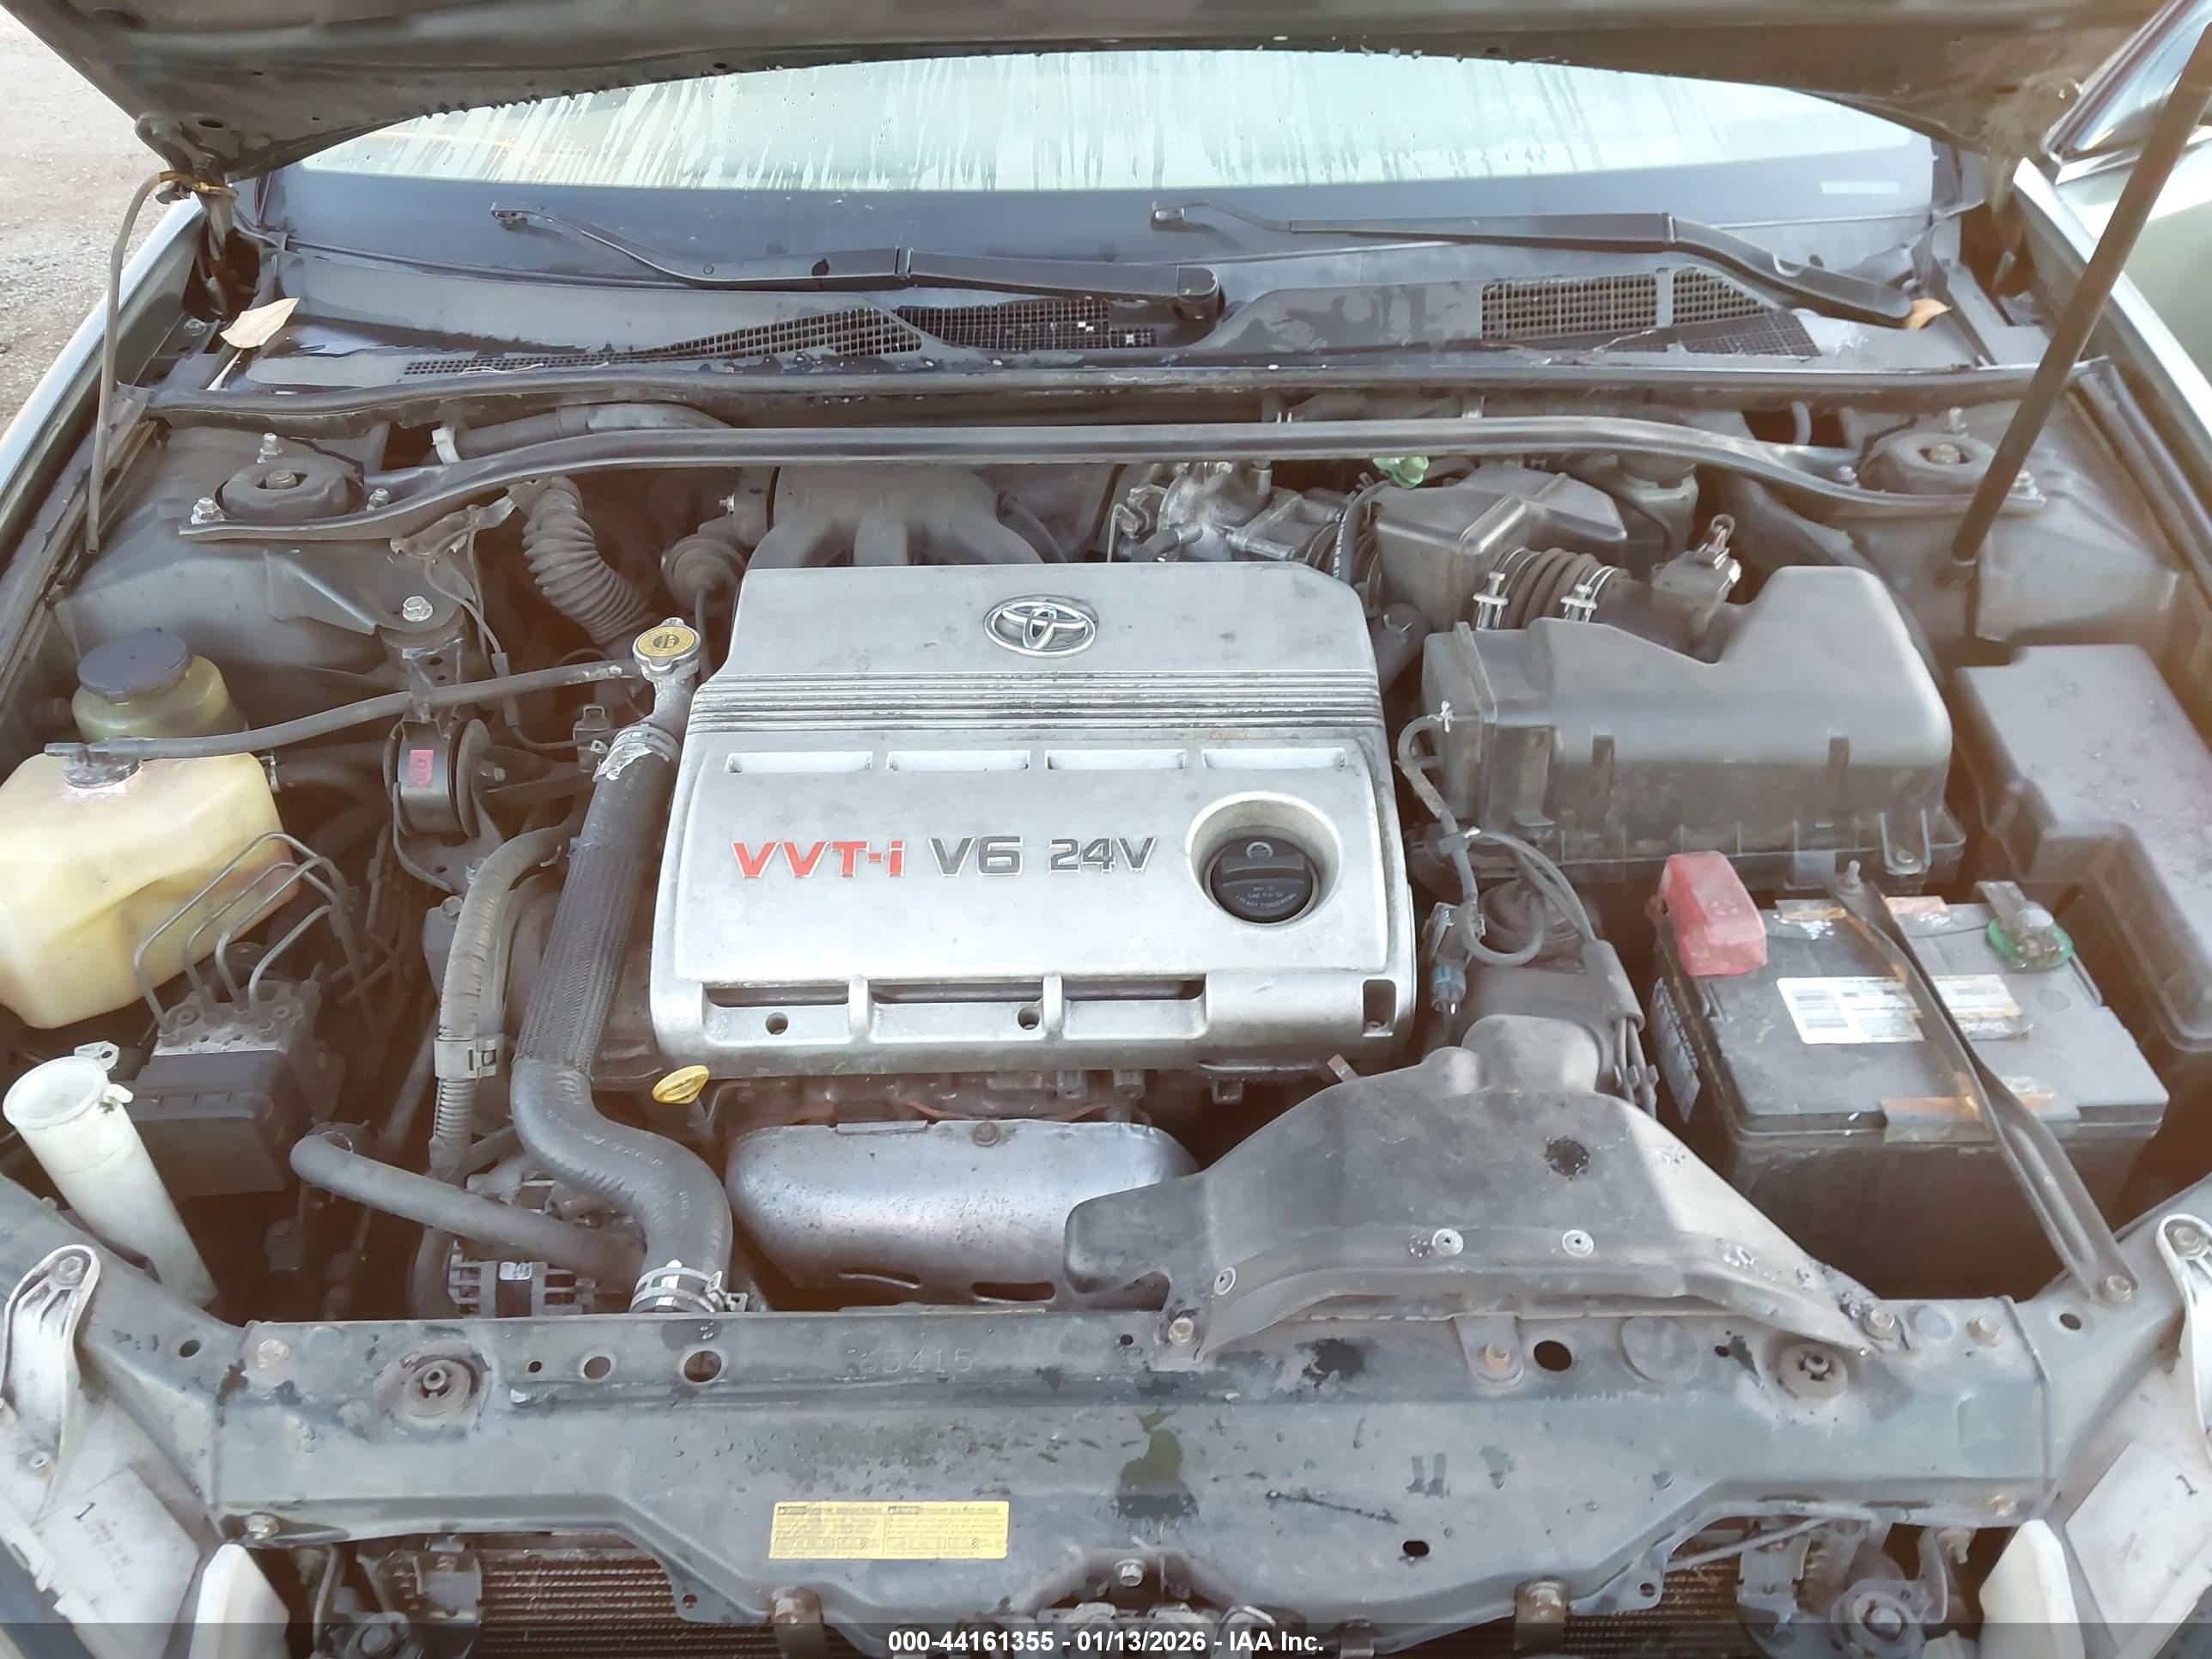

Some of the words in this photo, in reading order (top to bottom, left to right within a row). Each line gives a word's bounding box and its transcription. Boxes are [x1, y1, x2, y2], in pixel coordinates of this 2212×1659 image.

[731, 841, 906, 878] VVT-i
[927, 836, 1024, 878] V6
[1048, 837, 1158, 873] 24V
